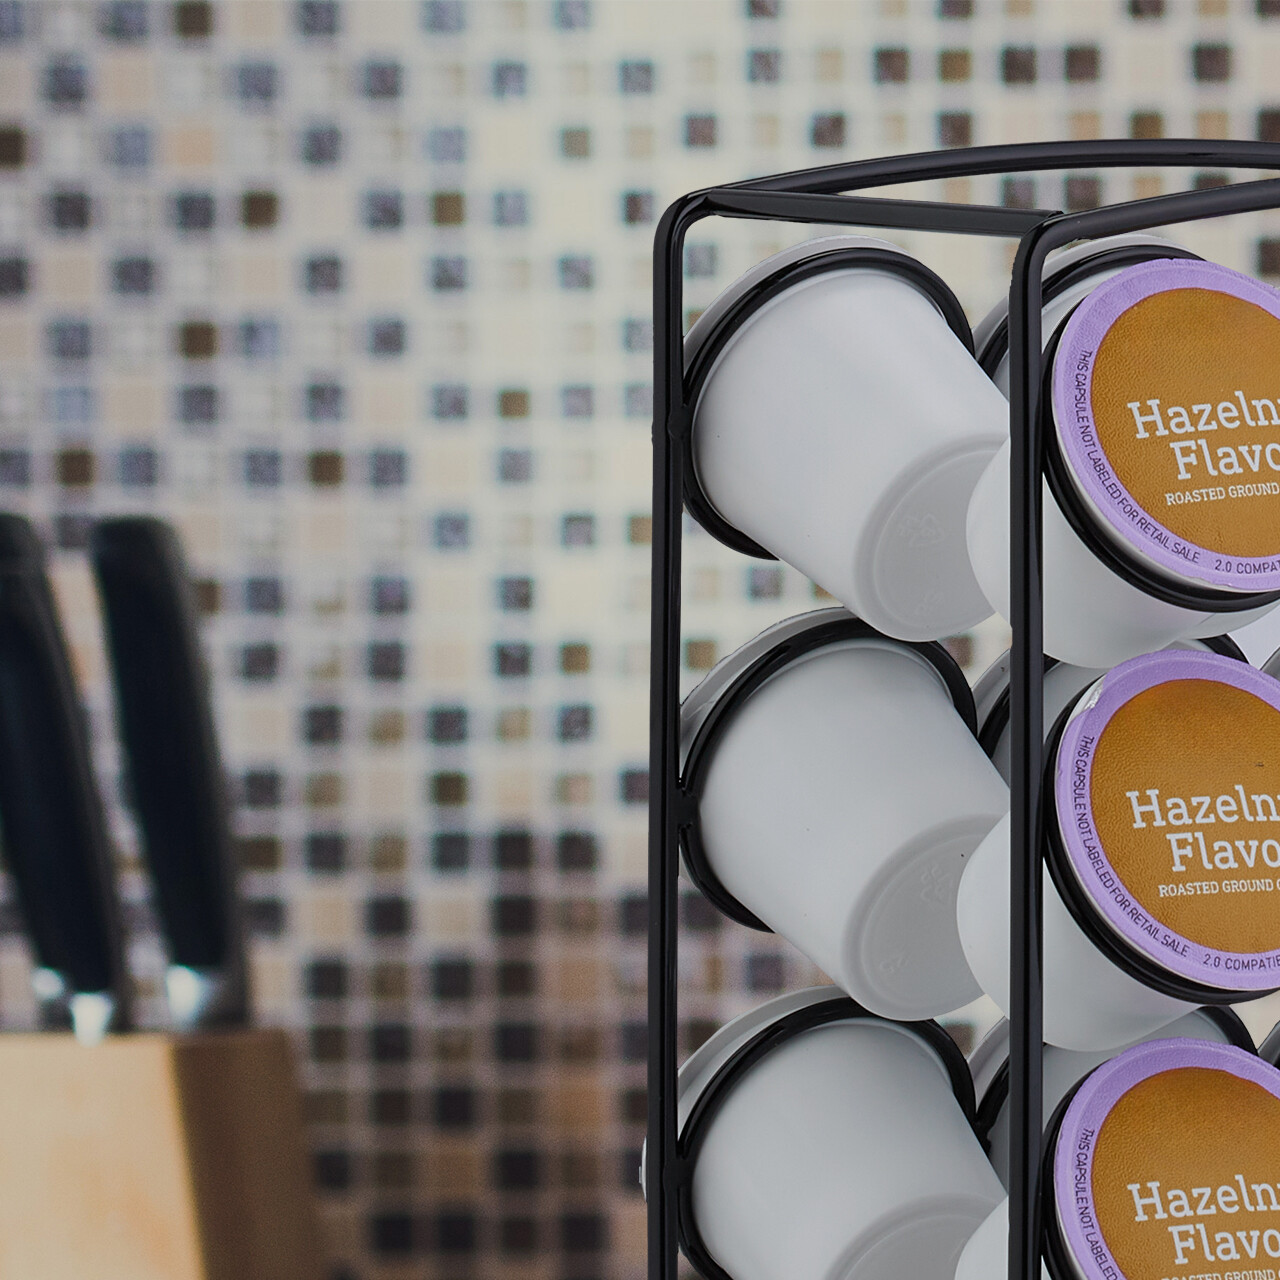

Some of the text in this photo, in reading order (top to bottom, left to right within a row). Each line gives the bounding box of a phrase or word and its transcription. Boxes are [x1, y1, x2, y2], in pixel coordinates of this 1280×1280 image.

[1074, 350, 1201, 564] THIS CAPSULE NOT LABELED FOR RETAIL SALE
[1165, 487, 1226, 506] ROASTED
[1228, 481, 1280, 498] GROUND
[1214, 559, 1232, 573] 2.0
[1158, 881, 1219, 897] ROASTED
[1222, 878, 1274, 893] GROUND
[1203, 953, 1221, 968] 2.0
